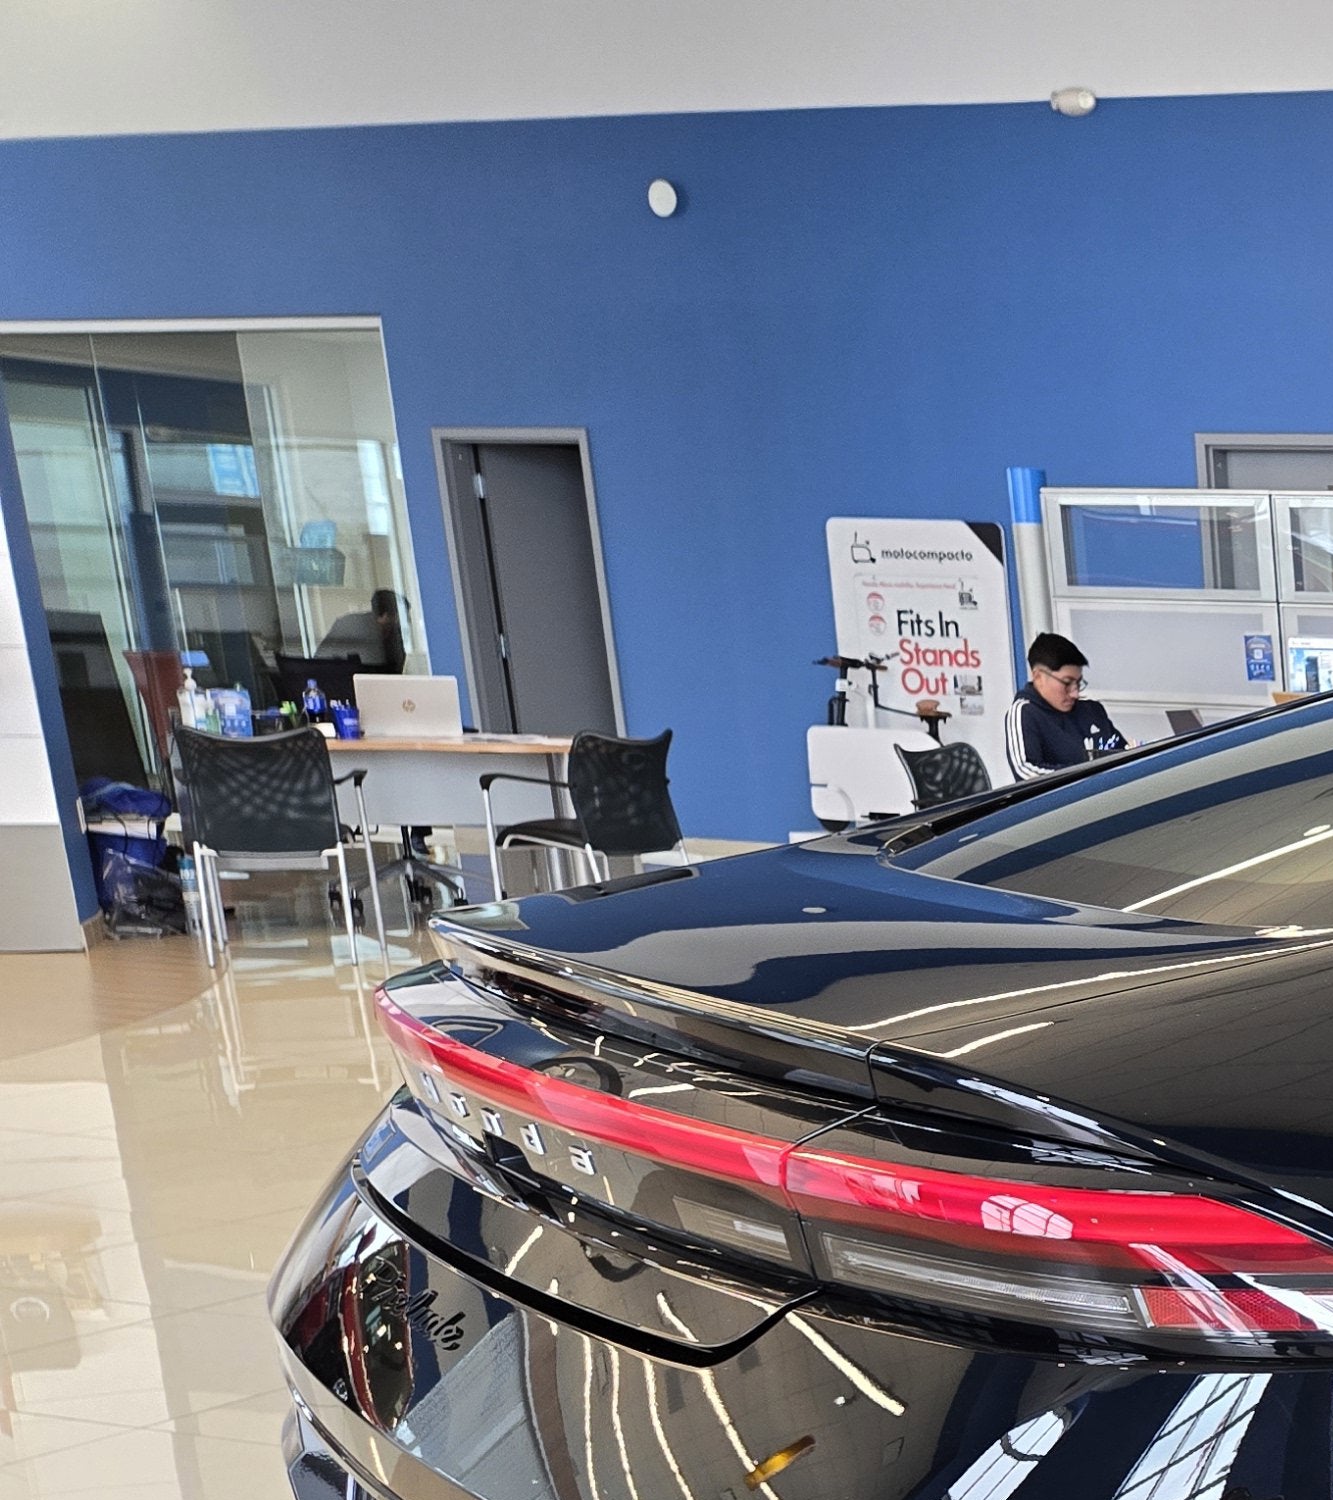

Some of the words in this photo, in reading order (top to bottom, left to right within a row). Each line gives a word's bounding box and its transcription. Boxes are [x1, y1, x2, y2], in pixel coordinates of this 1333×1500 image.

[896, 609, 936, 638] Fits
[939, 610, 960, 638] In
[899, 638, 982, 669] Stands
[902, 667, 949, 696] Out
